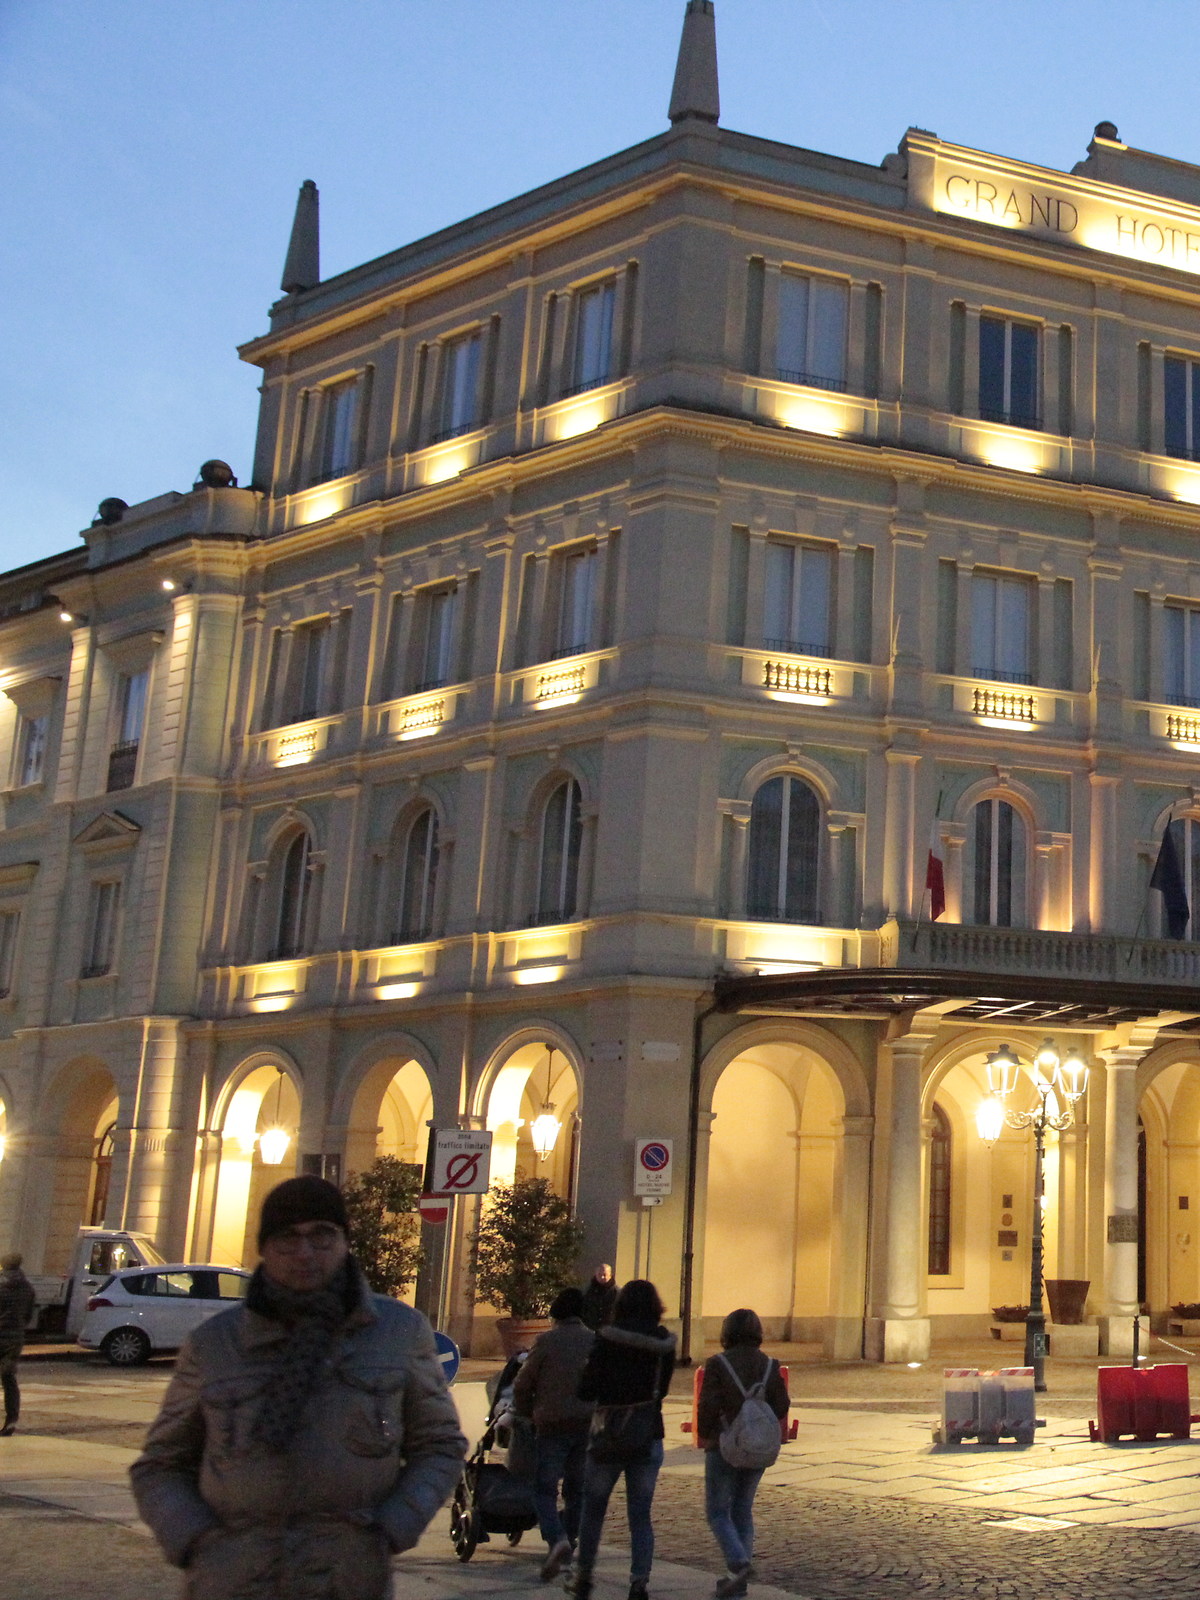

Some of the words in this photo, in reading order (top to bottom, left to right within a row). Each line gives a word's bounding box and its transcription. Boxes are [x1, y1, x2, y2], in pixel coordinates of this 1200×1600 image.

[945, 174, 1079, 234] GRAND
[438, 1141, 462, 1149] traffico
[464, 1142, 490, 1150] limitato
